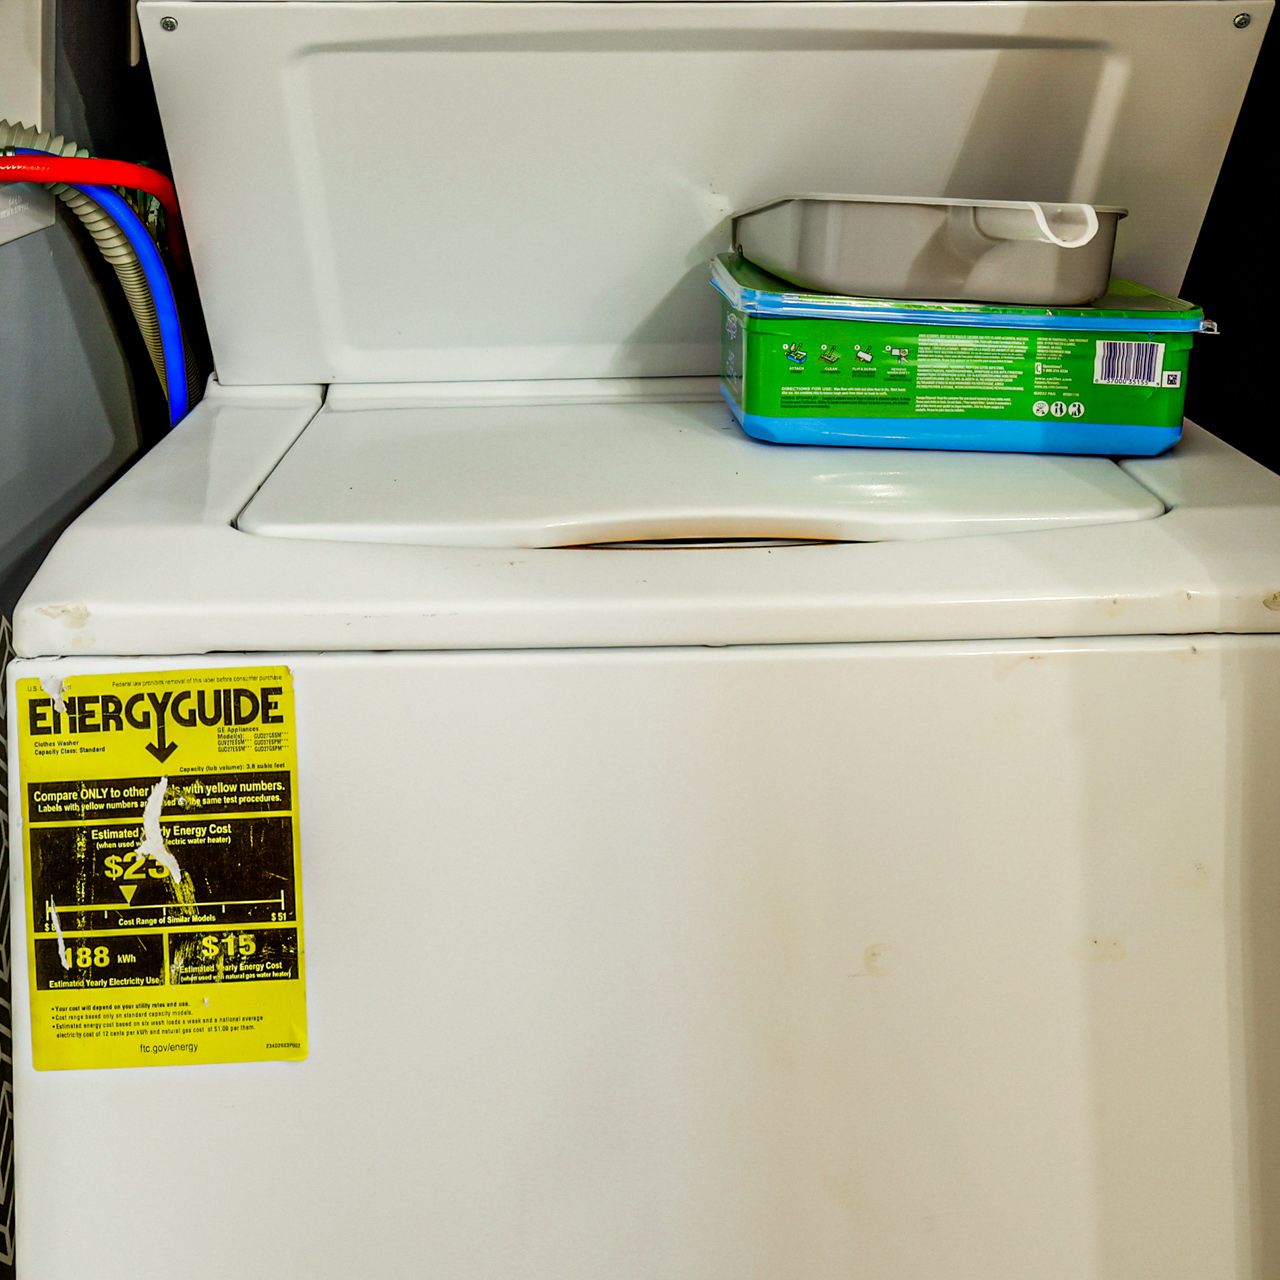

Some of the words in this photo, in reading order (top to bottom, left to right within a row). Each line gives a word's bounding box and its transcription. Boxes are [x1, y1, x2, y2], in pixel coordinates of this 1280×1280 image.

[28, 687, 284, 736] ENERGYGUIDE
[34, 748, 59, 756] Capacity
[34, 790, 78, 803] Compare
[80, 788, 108, 799] ONLY
[110, 788, 121, 798] to
[123, 786, 149, 797] other
[183, 781, 204, 794] with
[206, 782, 238, 796] yellow
[239, 780, 286, 792] numbers.
[38, 804, 63, 812] Labels
[64, 803, 80, 811] with
[81, 802, 104, 811] yellow
[106, 800, 138, 809] numbers
[202, 797, 222, 805] same
[223, 796, 238, 804] test
[238, 794, 282, 805] procedures.
[91, 827, 139, 840] Estimated
[173, 824, 207, 837] Energy
[209, 823, 232, 834] Cost
[96, 841, 116, 850] (when
[187, 837, 206, 845] water
[207, 836, 231, 844] heater)
[118, 917, 134, 926] Cost
[136, 916, 157, 926] Range
[158, 916, 166, 924] of
[167, 915, 190, 924] Similar
[192, 914, 216, 923] Models
[271, 912, 276, 922] $
[278, 912, 287, 921] 51
[201, 934, 257, 957] $15
[65, 946, 110, 968] 188
[117, 954, 136, 964] kWh
[239, 962, 264, 972] Energy
[265, 961, 282, 970] Cost
[49, 980, 84, 988] Estimated
[86, 979, 108, 988] Yearly
[109, 977, 144, 986] Electricity
[146, 976, 160, 984] Use
[225, 971, 245, 980] natural
[245, 972, 256, 980] gas
[139, 1042, 199, 1053] ftc.gov/energy
